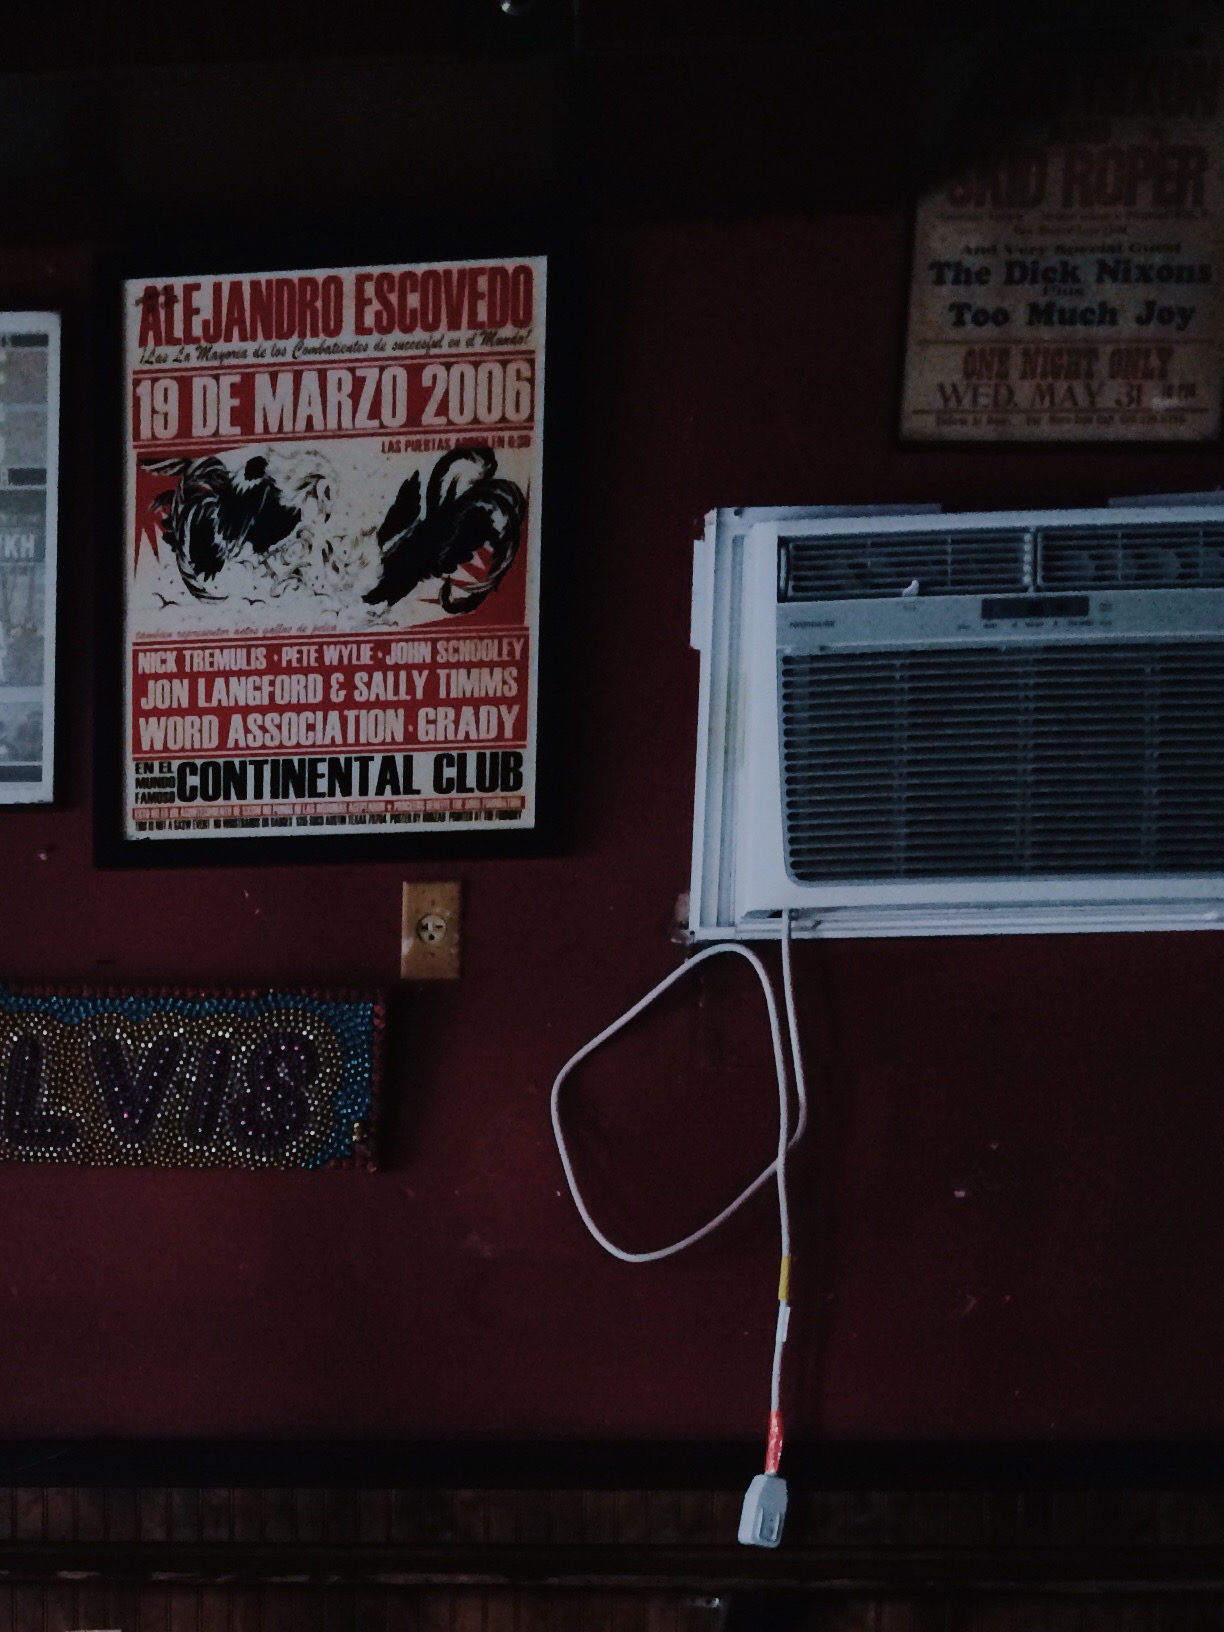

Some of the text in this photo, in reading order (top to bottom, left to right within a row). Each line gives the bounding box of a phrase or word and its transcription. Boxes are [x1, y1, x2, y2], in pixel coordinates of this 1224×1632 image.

[1061, 145, 1209, 208] ROPER
[929, 258, 1213, 286] The Dick Nixons
[139, 264, 534, 347] ALEJANDRO ESCOVEDO
[949, 300, 1197, 332] Too Much Joy
[252, 343, 268, 358] de
[963, 347, 1175, 381] ONE NIGHT ONLY
[134, 359, 533, 441] 19 DE MARZO 2006
[1032, 381, 1106, 408] MAY
[137, 637, 525, 675] NICK TREMULIS PETE WYLIE JOHN SCHOOLEY
[140, 666, 519, 711] JON LANGFORD & SALLY TIMMS
[138, 704, 521, 752] WORD ASSOCIATION GRADY
[135, 761, 174, 775] EN EL
[135, 775, 176, 790] MUNDO
[176, 750, 523, 802] CONTINENTAL CLUB
[134, 790, 176, 805] FAMOSO
